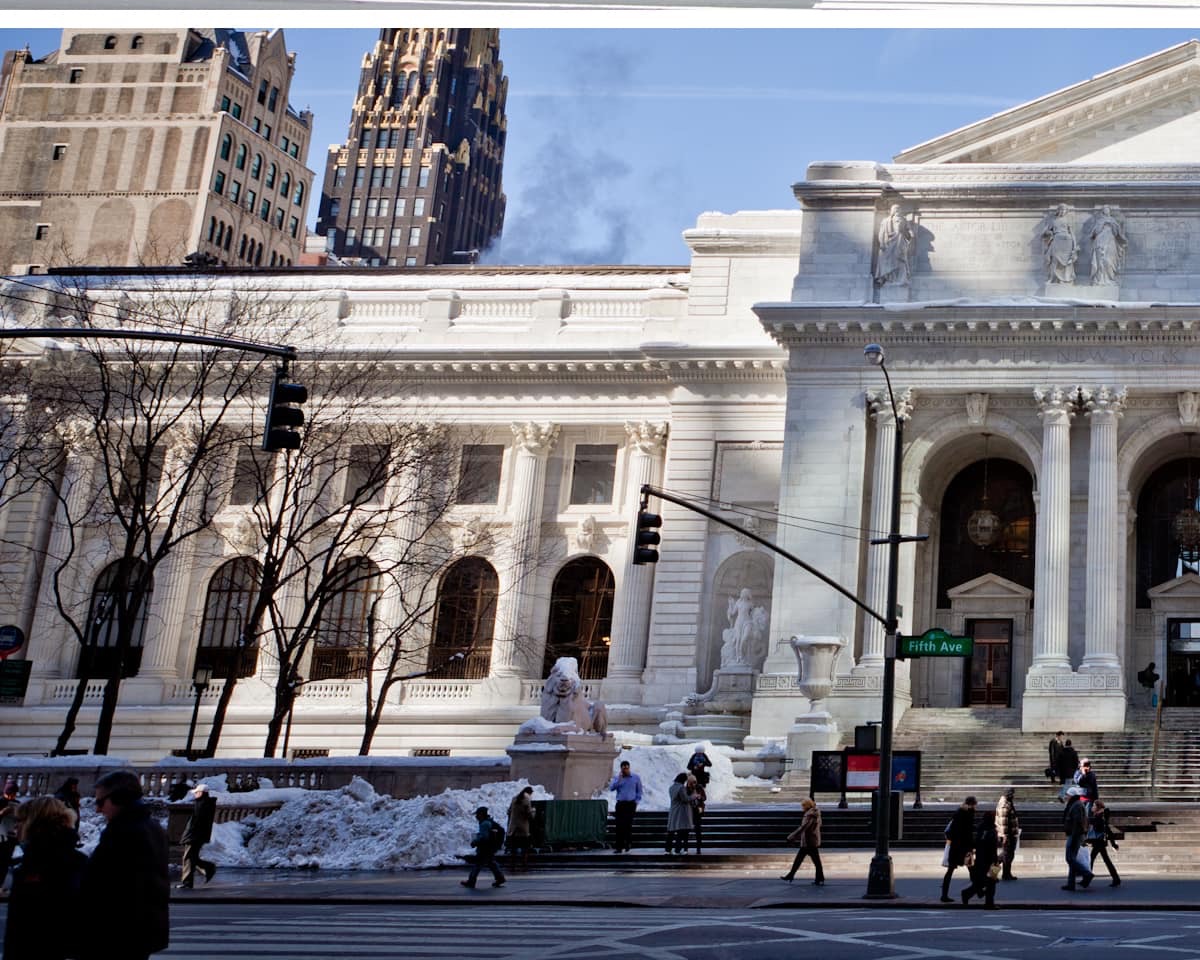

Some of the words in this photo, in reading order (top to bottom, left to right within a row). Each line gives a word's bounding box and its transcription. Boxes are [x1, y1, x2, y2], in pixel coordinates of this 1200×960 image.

[1000, 349, 1041, 363] THE
[1056, 350, 1108, 363] NEW
[908, 640, 936, 652] Fifth
[940, 641, 963, 652] Ave
